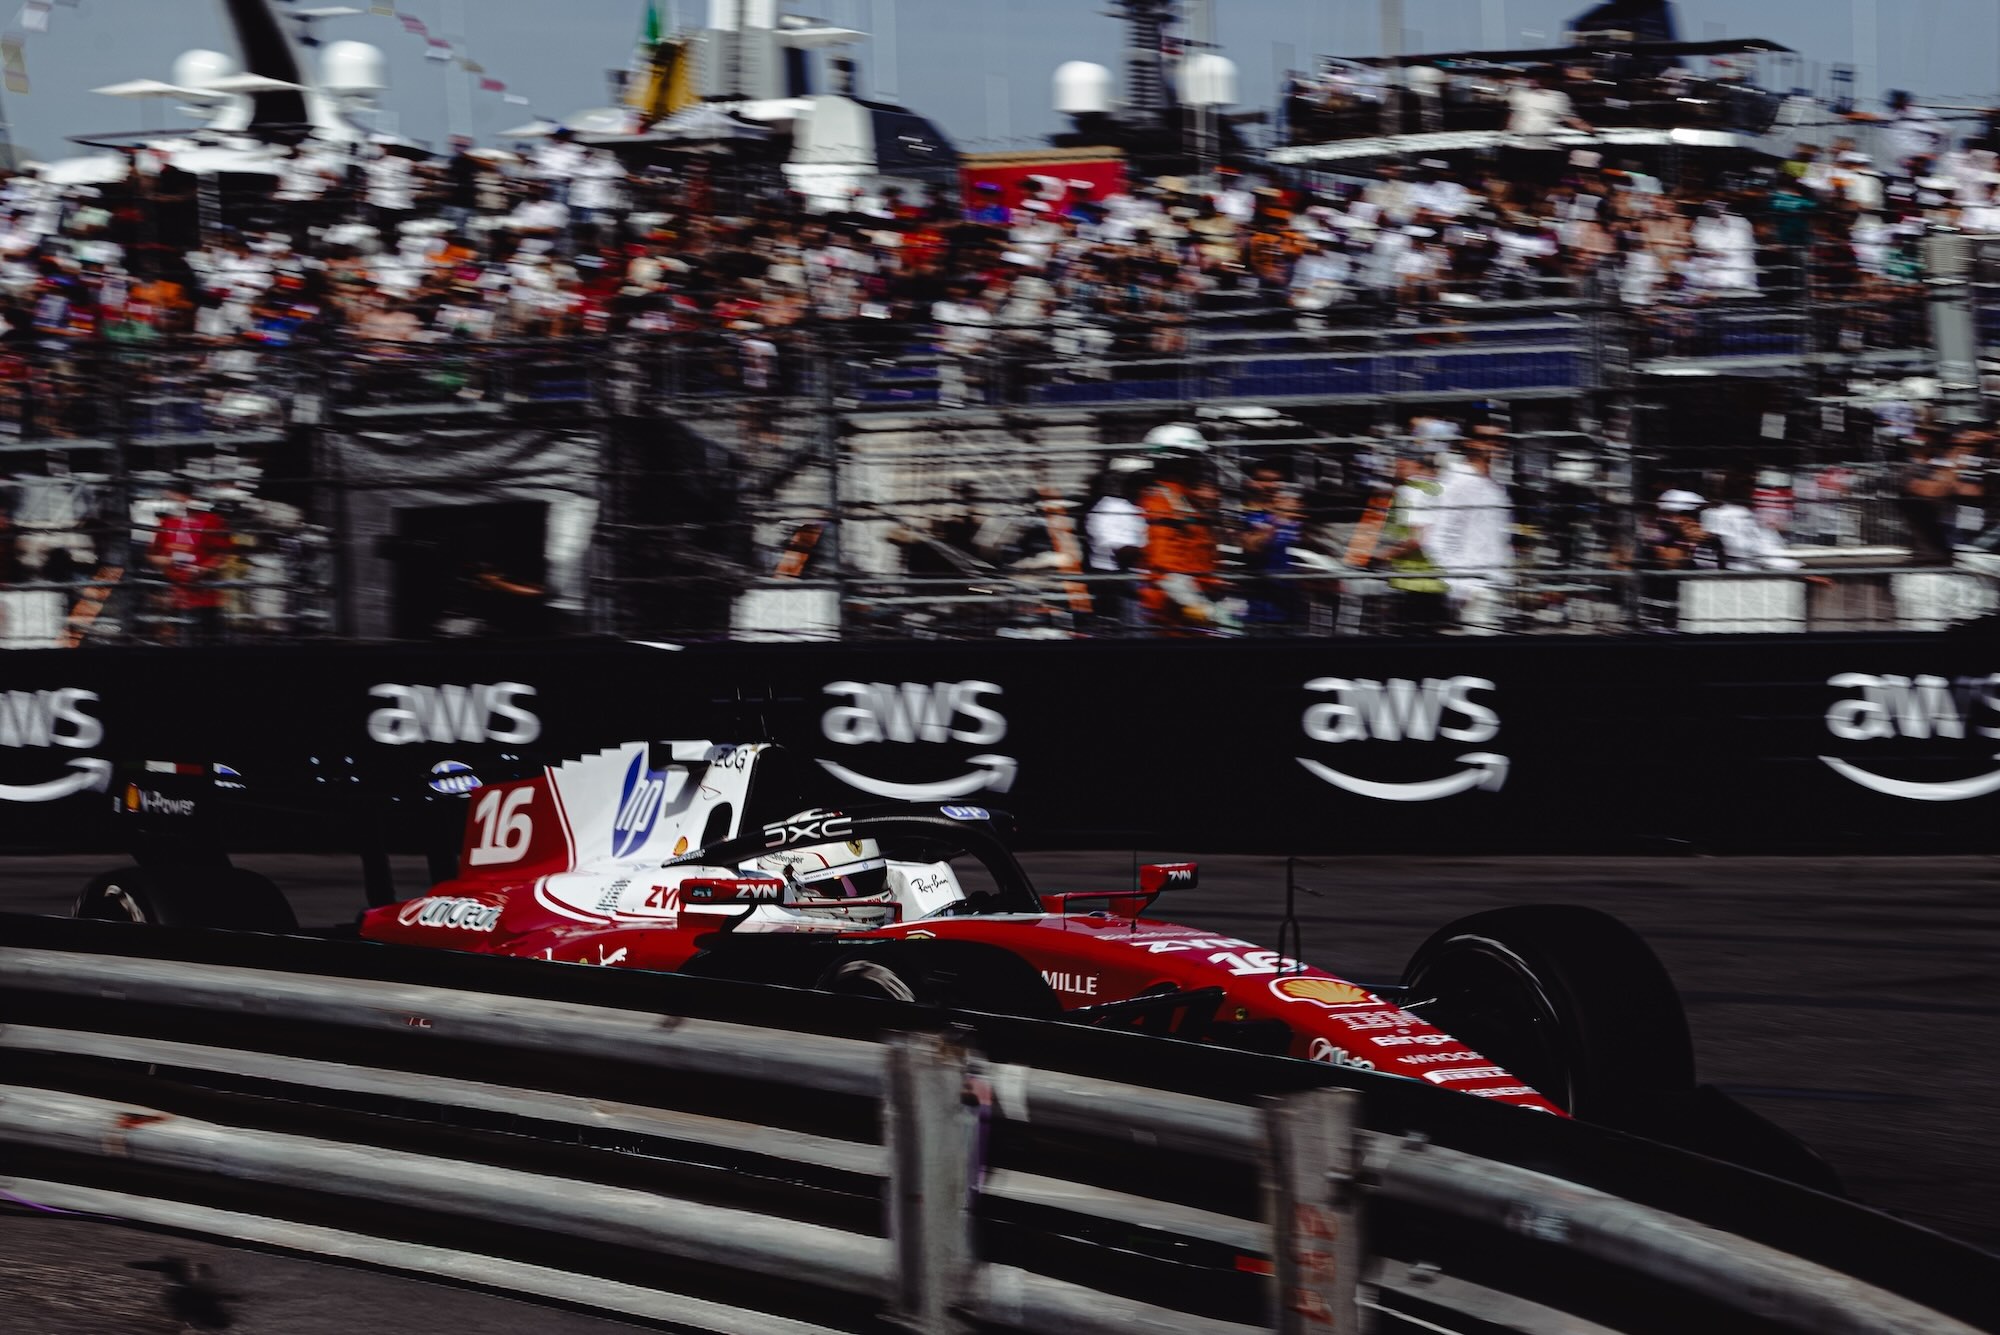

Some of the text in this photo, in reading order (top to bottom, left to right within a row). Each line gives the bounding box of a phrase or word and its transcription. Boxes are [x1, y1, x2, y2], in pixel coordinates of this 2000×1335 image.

[0, 687, 104, 748] ws
[367, 681, 542, 745] aws
[821, 679, 1008, 745] aws
[1302, 675, 1501, 743] aws
[612, 742, 667, 858] hp
[470, 786, 534, 866] 16
[763, 817, 853, 848] DXC
[736, 884, 777, 899] ZYN
[911, 874, 948, 893] Ray-Ban
[1130, 938, 1261, 954] ZYN
[1207, 951, 1309, 976] 16
[1041, 970, 1098, 996] MILLE
[1328, 1009, 1431, 1031] IBM
